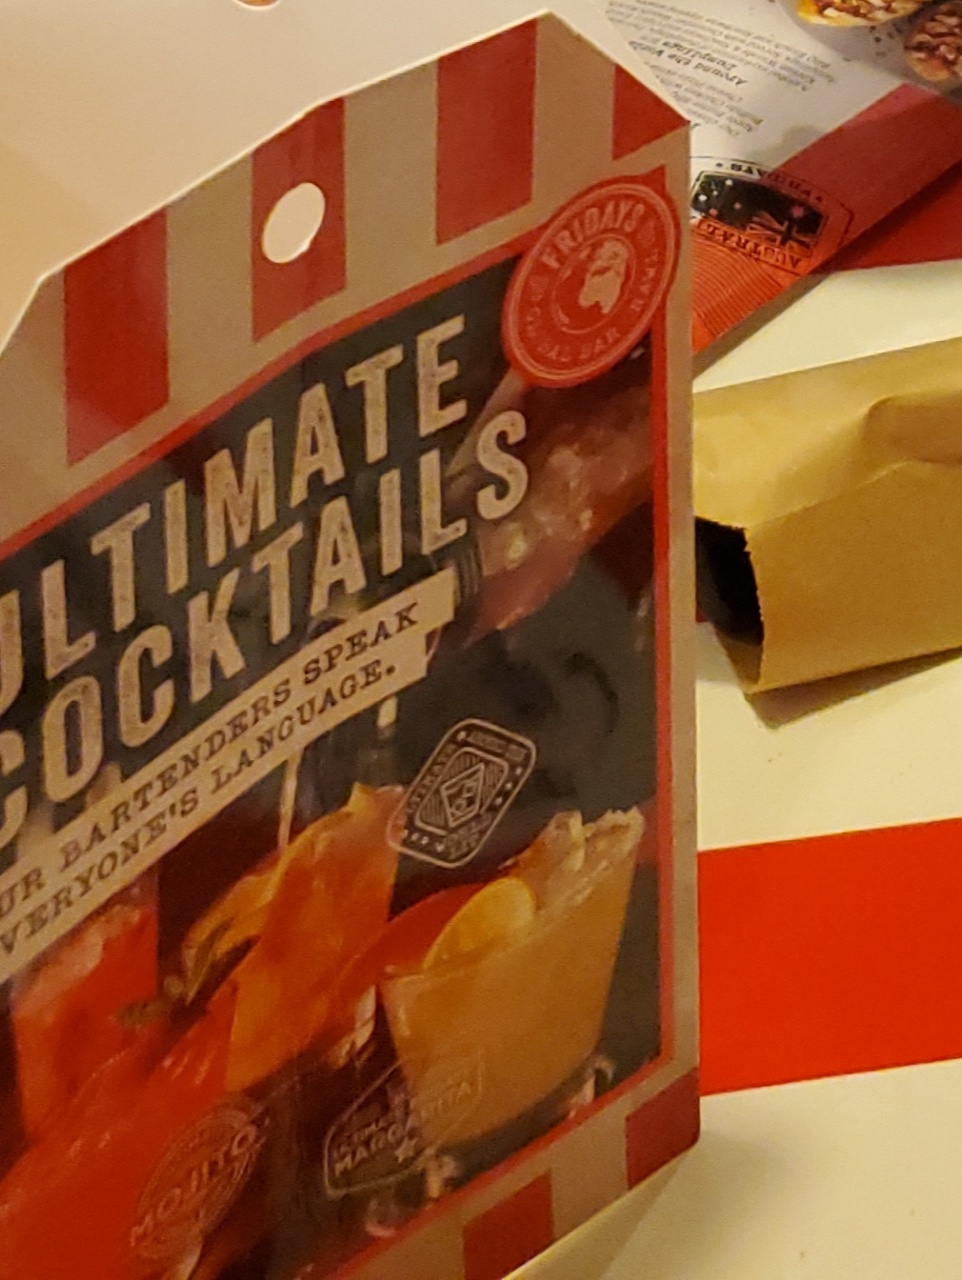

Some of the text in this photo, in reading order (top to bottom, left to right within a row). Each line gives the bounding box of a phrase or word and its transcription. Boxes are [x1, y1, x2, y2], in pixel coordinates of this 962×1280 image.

[540, 199, 645, 270] FRIDAYS
[60, 674, 291, 873] BARTENDERS
[302, 601, 419, 687] SPEAK
[210, 663, 397, 796] LANGUAGE.
